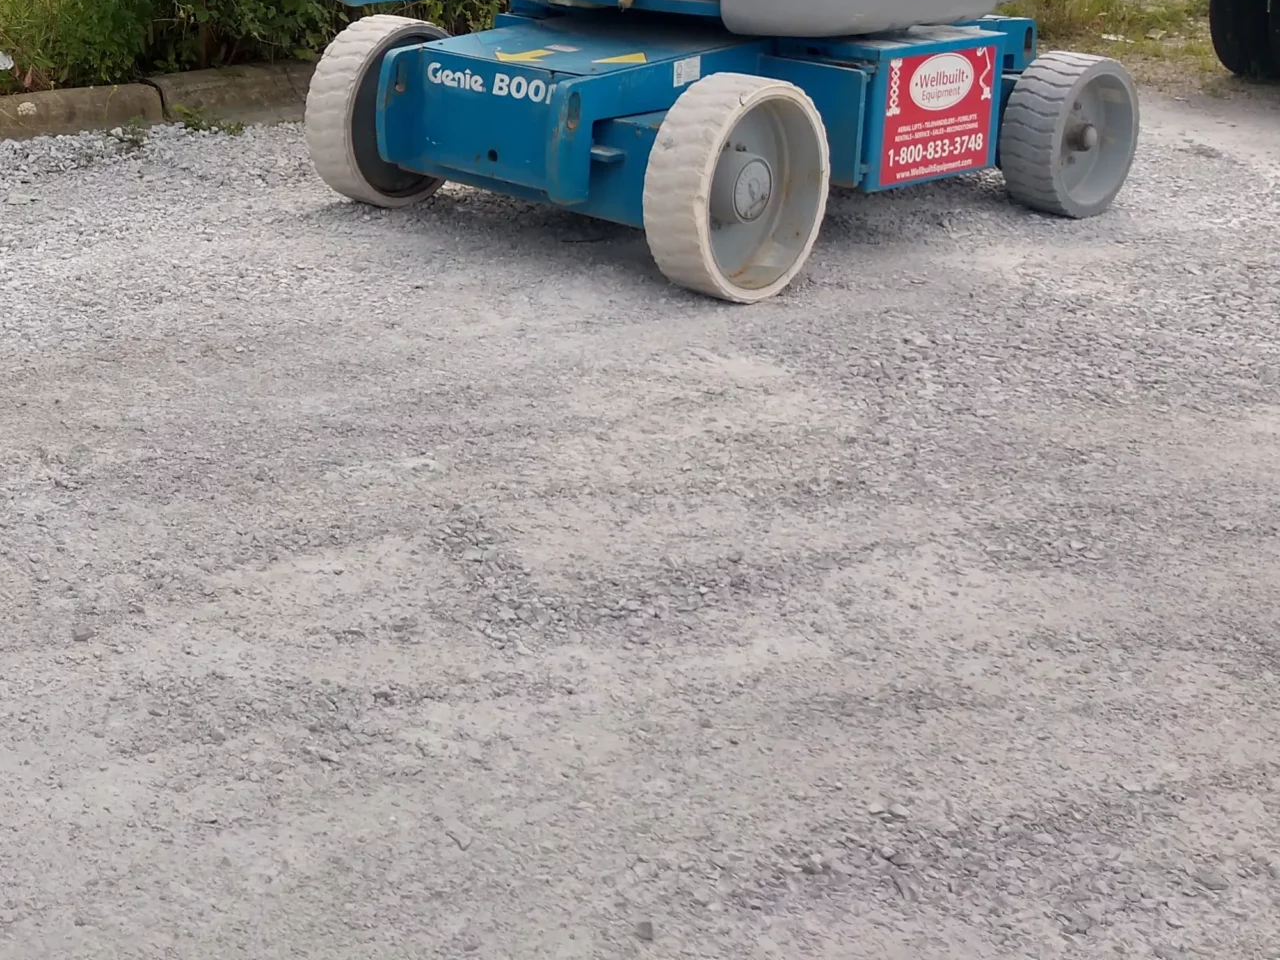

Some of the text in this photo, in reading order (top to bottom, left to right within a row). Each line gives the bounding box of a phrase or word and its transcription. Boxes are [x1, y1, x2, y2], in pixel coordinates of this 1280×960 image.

[919, 68, 965, 89] Wellbuilt
[921, 86, 961, 102] Equipment
[888, 133, 983, 167] 1-800-833-3748
